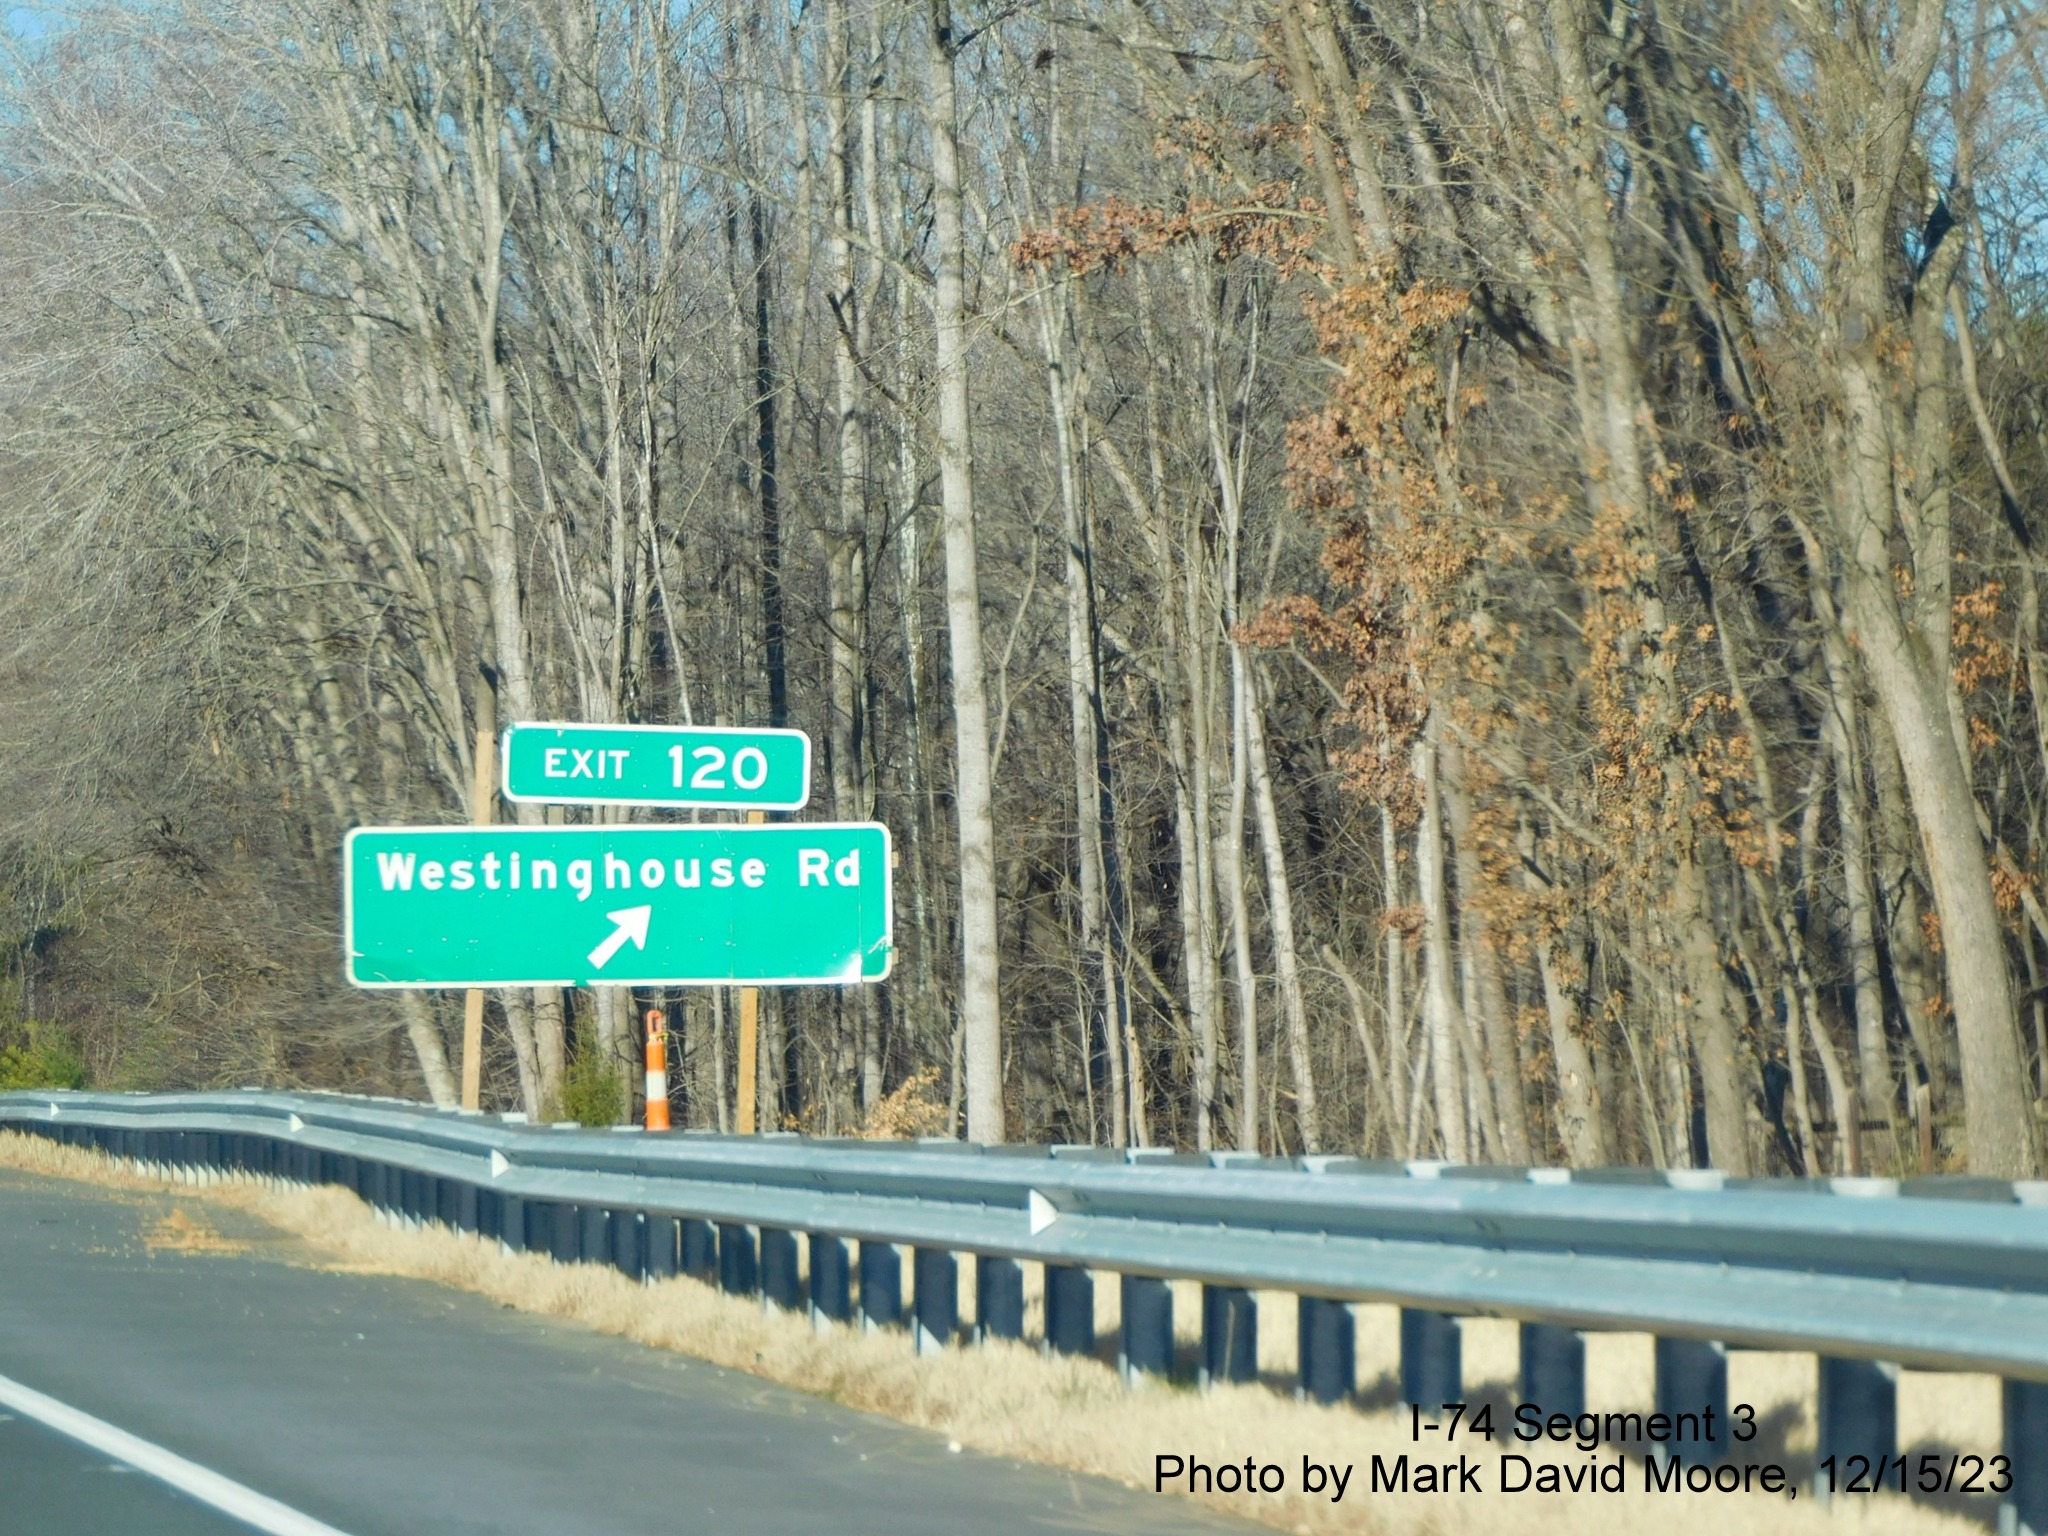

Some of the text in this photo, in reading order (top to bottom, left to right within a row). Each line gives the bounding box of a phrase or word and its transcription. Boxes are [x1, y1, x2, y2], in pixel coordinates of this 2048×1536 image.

[544, 745, 768, 790] EXIT 120
[377, 848, 860, 902] Westinghouse Rd
